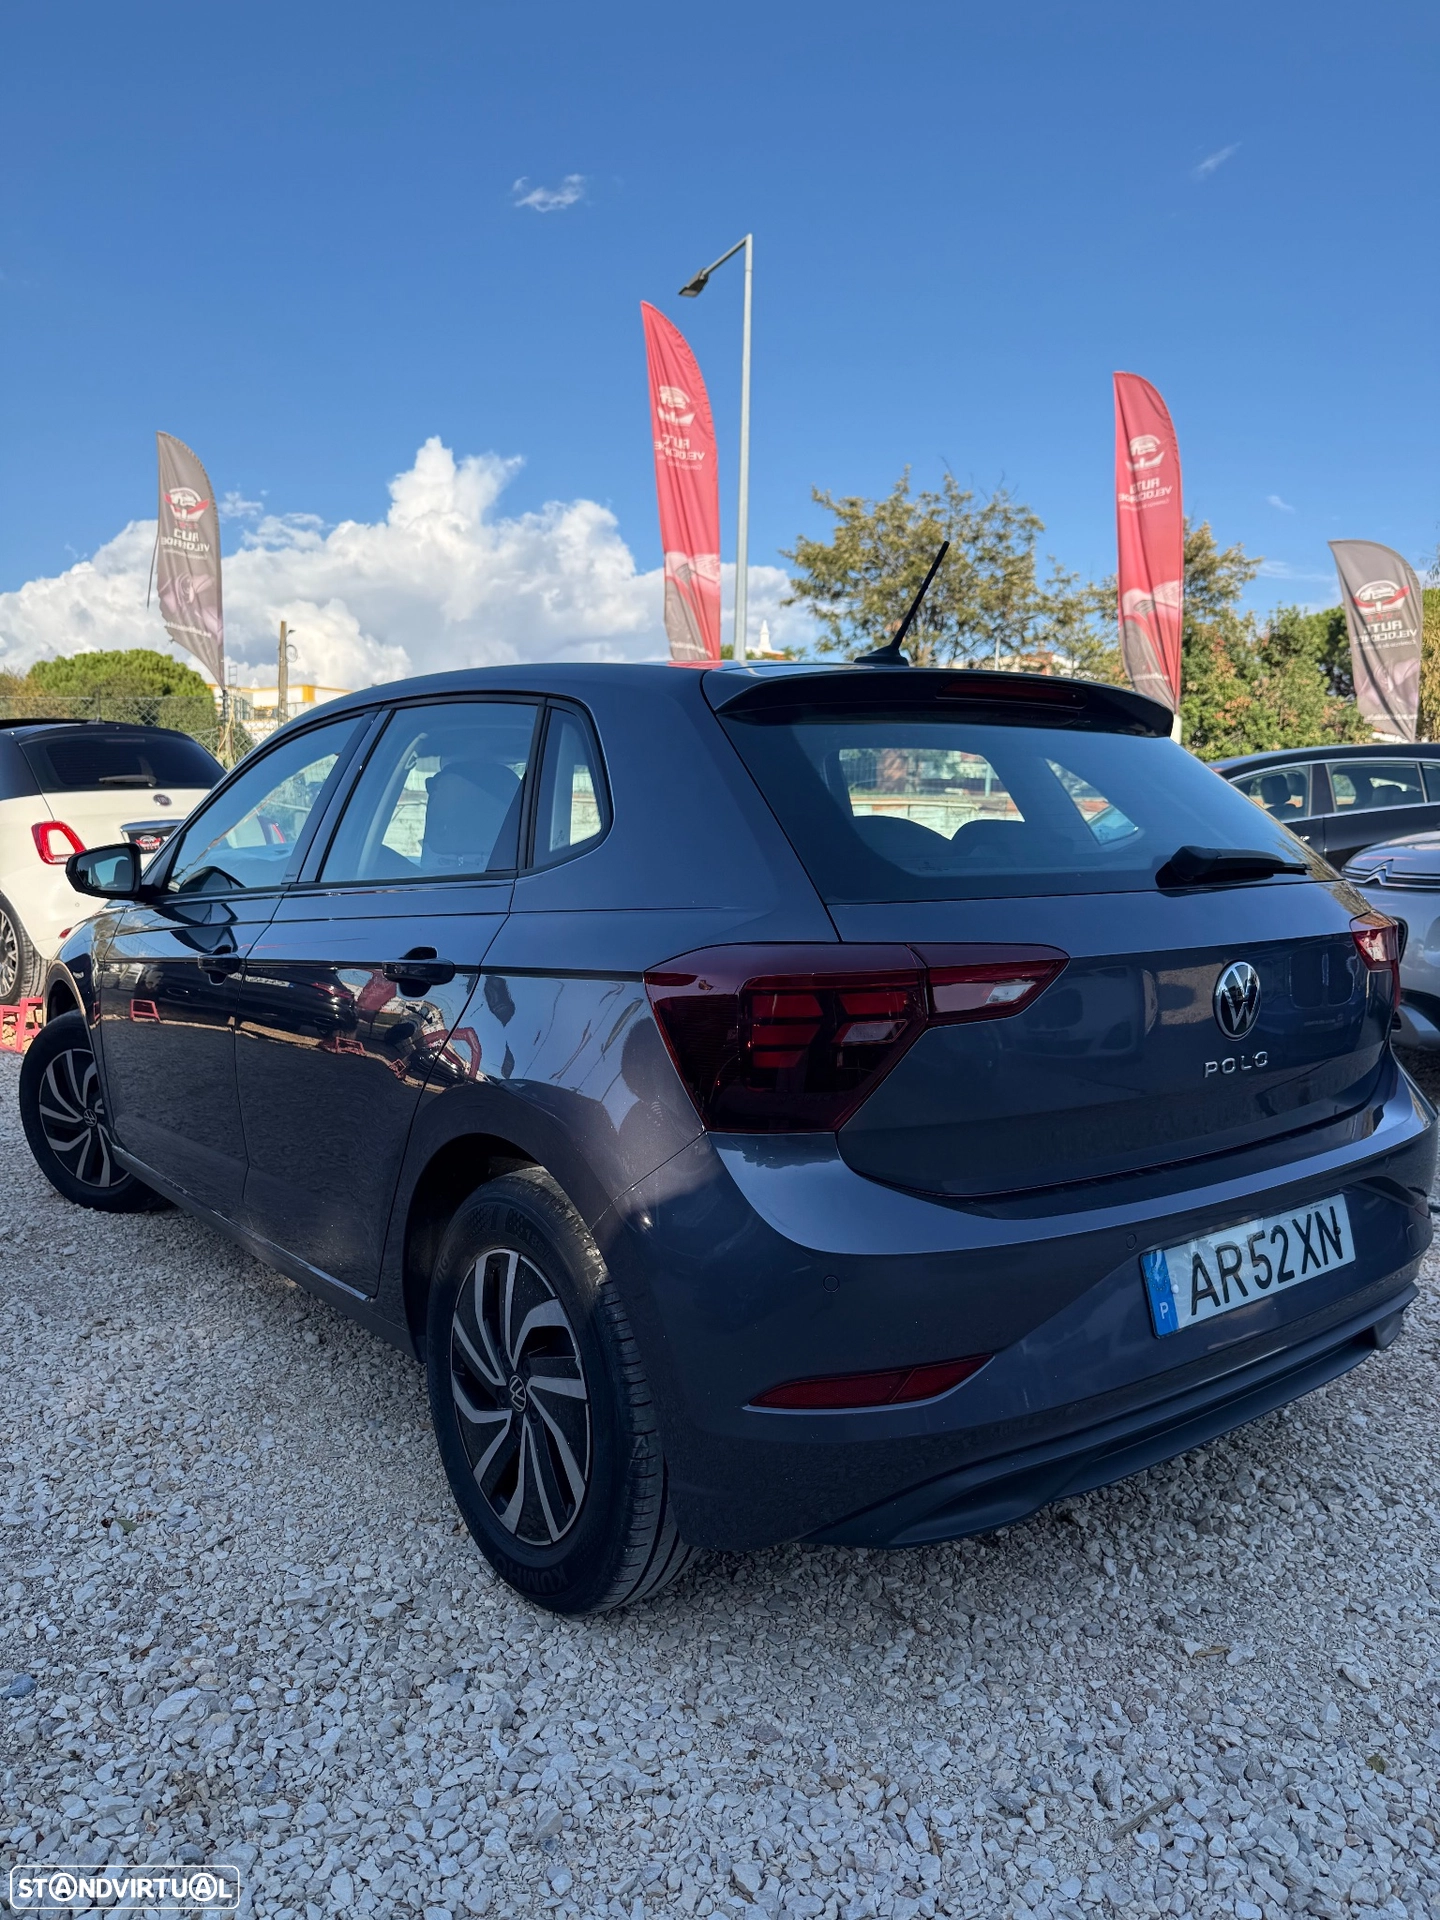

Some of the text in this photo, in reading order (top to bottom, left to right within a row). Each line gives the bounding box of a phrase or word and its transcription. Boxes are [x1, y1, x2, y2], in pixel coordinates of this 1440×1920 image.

[1204, 1051, 1268, 1078] POLO
[1160, 1206, 1343, 1319] P AR52XN
[494, 1553, 569, 1593] KUMHO
